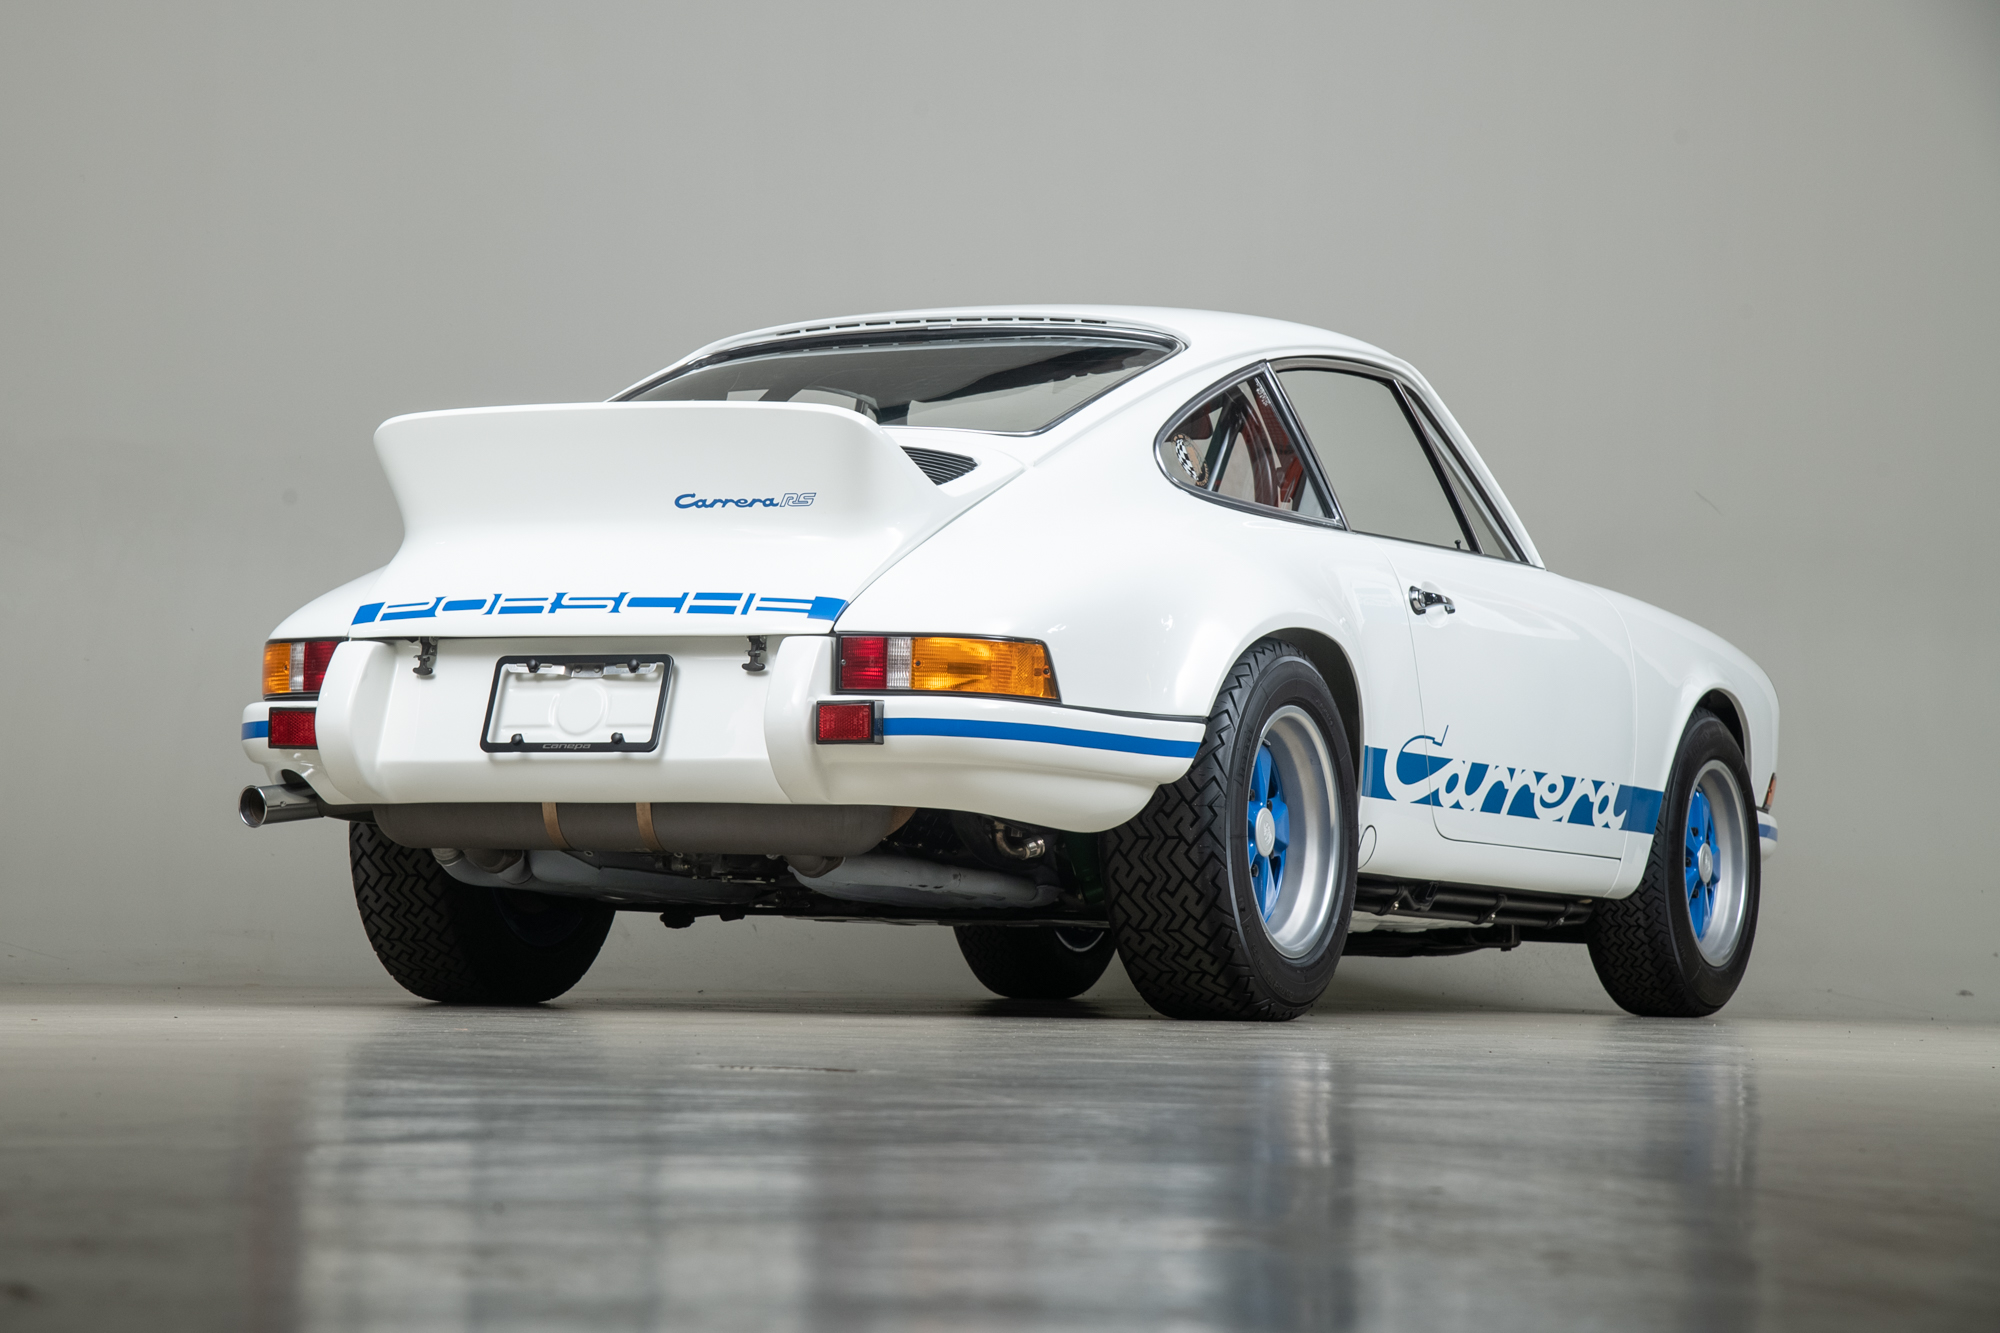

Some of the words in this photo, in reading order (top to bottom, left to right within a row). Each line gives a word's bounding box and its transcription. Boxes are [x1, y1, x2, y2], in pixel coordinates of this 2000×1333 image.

[674, 493, 779, 509] Carrera
[779, 492, 817, 507] RS
[373, 592, 816, 622] PORSCHE
[1384, 725, 1628, 831] Carrera
